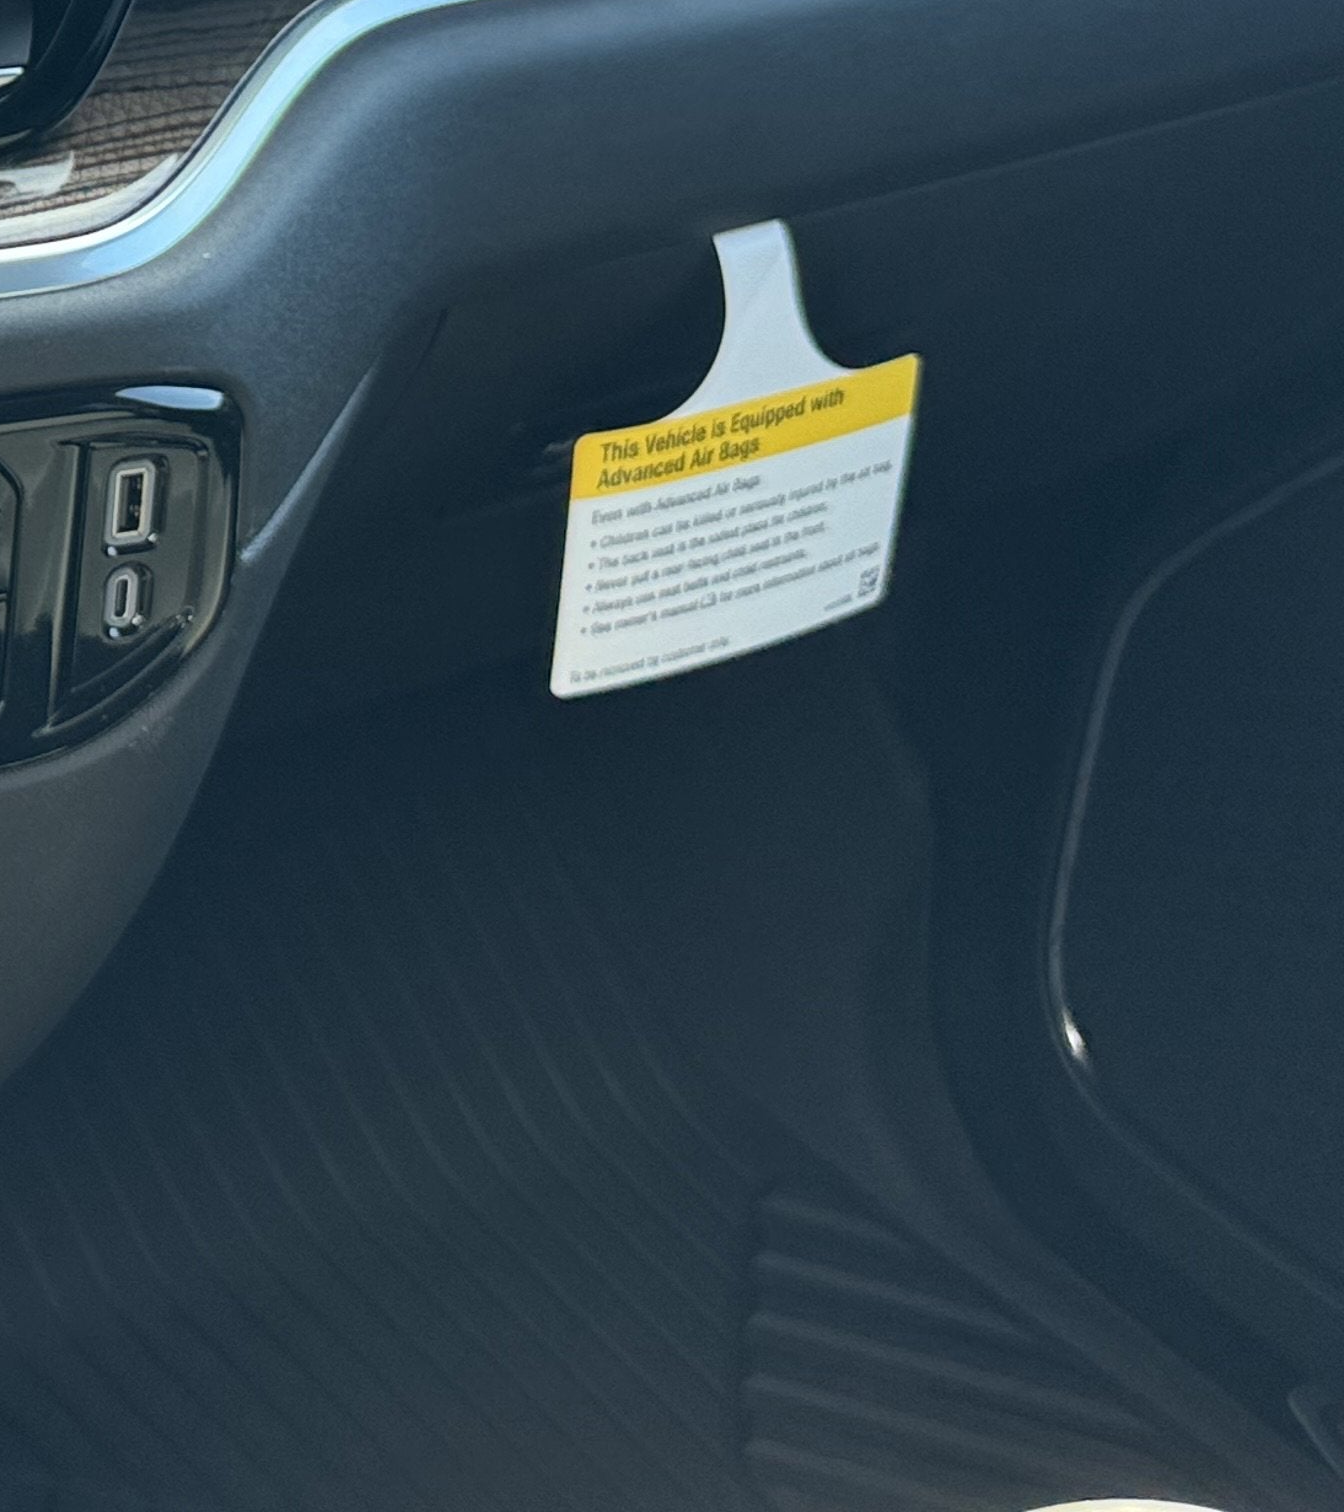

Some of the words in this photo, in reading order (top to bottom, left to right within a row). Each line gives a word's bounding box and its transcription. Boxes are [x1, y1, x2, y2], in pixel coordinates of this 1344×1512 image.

[601, 441, 639, 463] This
[645, 424, 706, 455] Vehicle
[711, 418, 726, 438] is
[730, 396, 806, 434] Equipped
[811, 388, 845, 411] with
[597, 453, 685, 488] Advanced
[690, 448, 714, 470] Air
[718, 438, 759, 463] Bags
